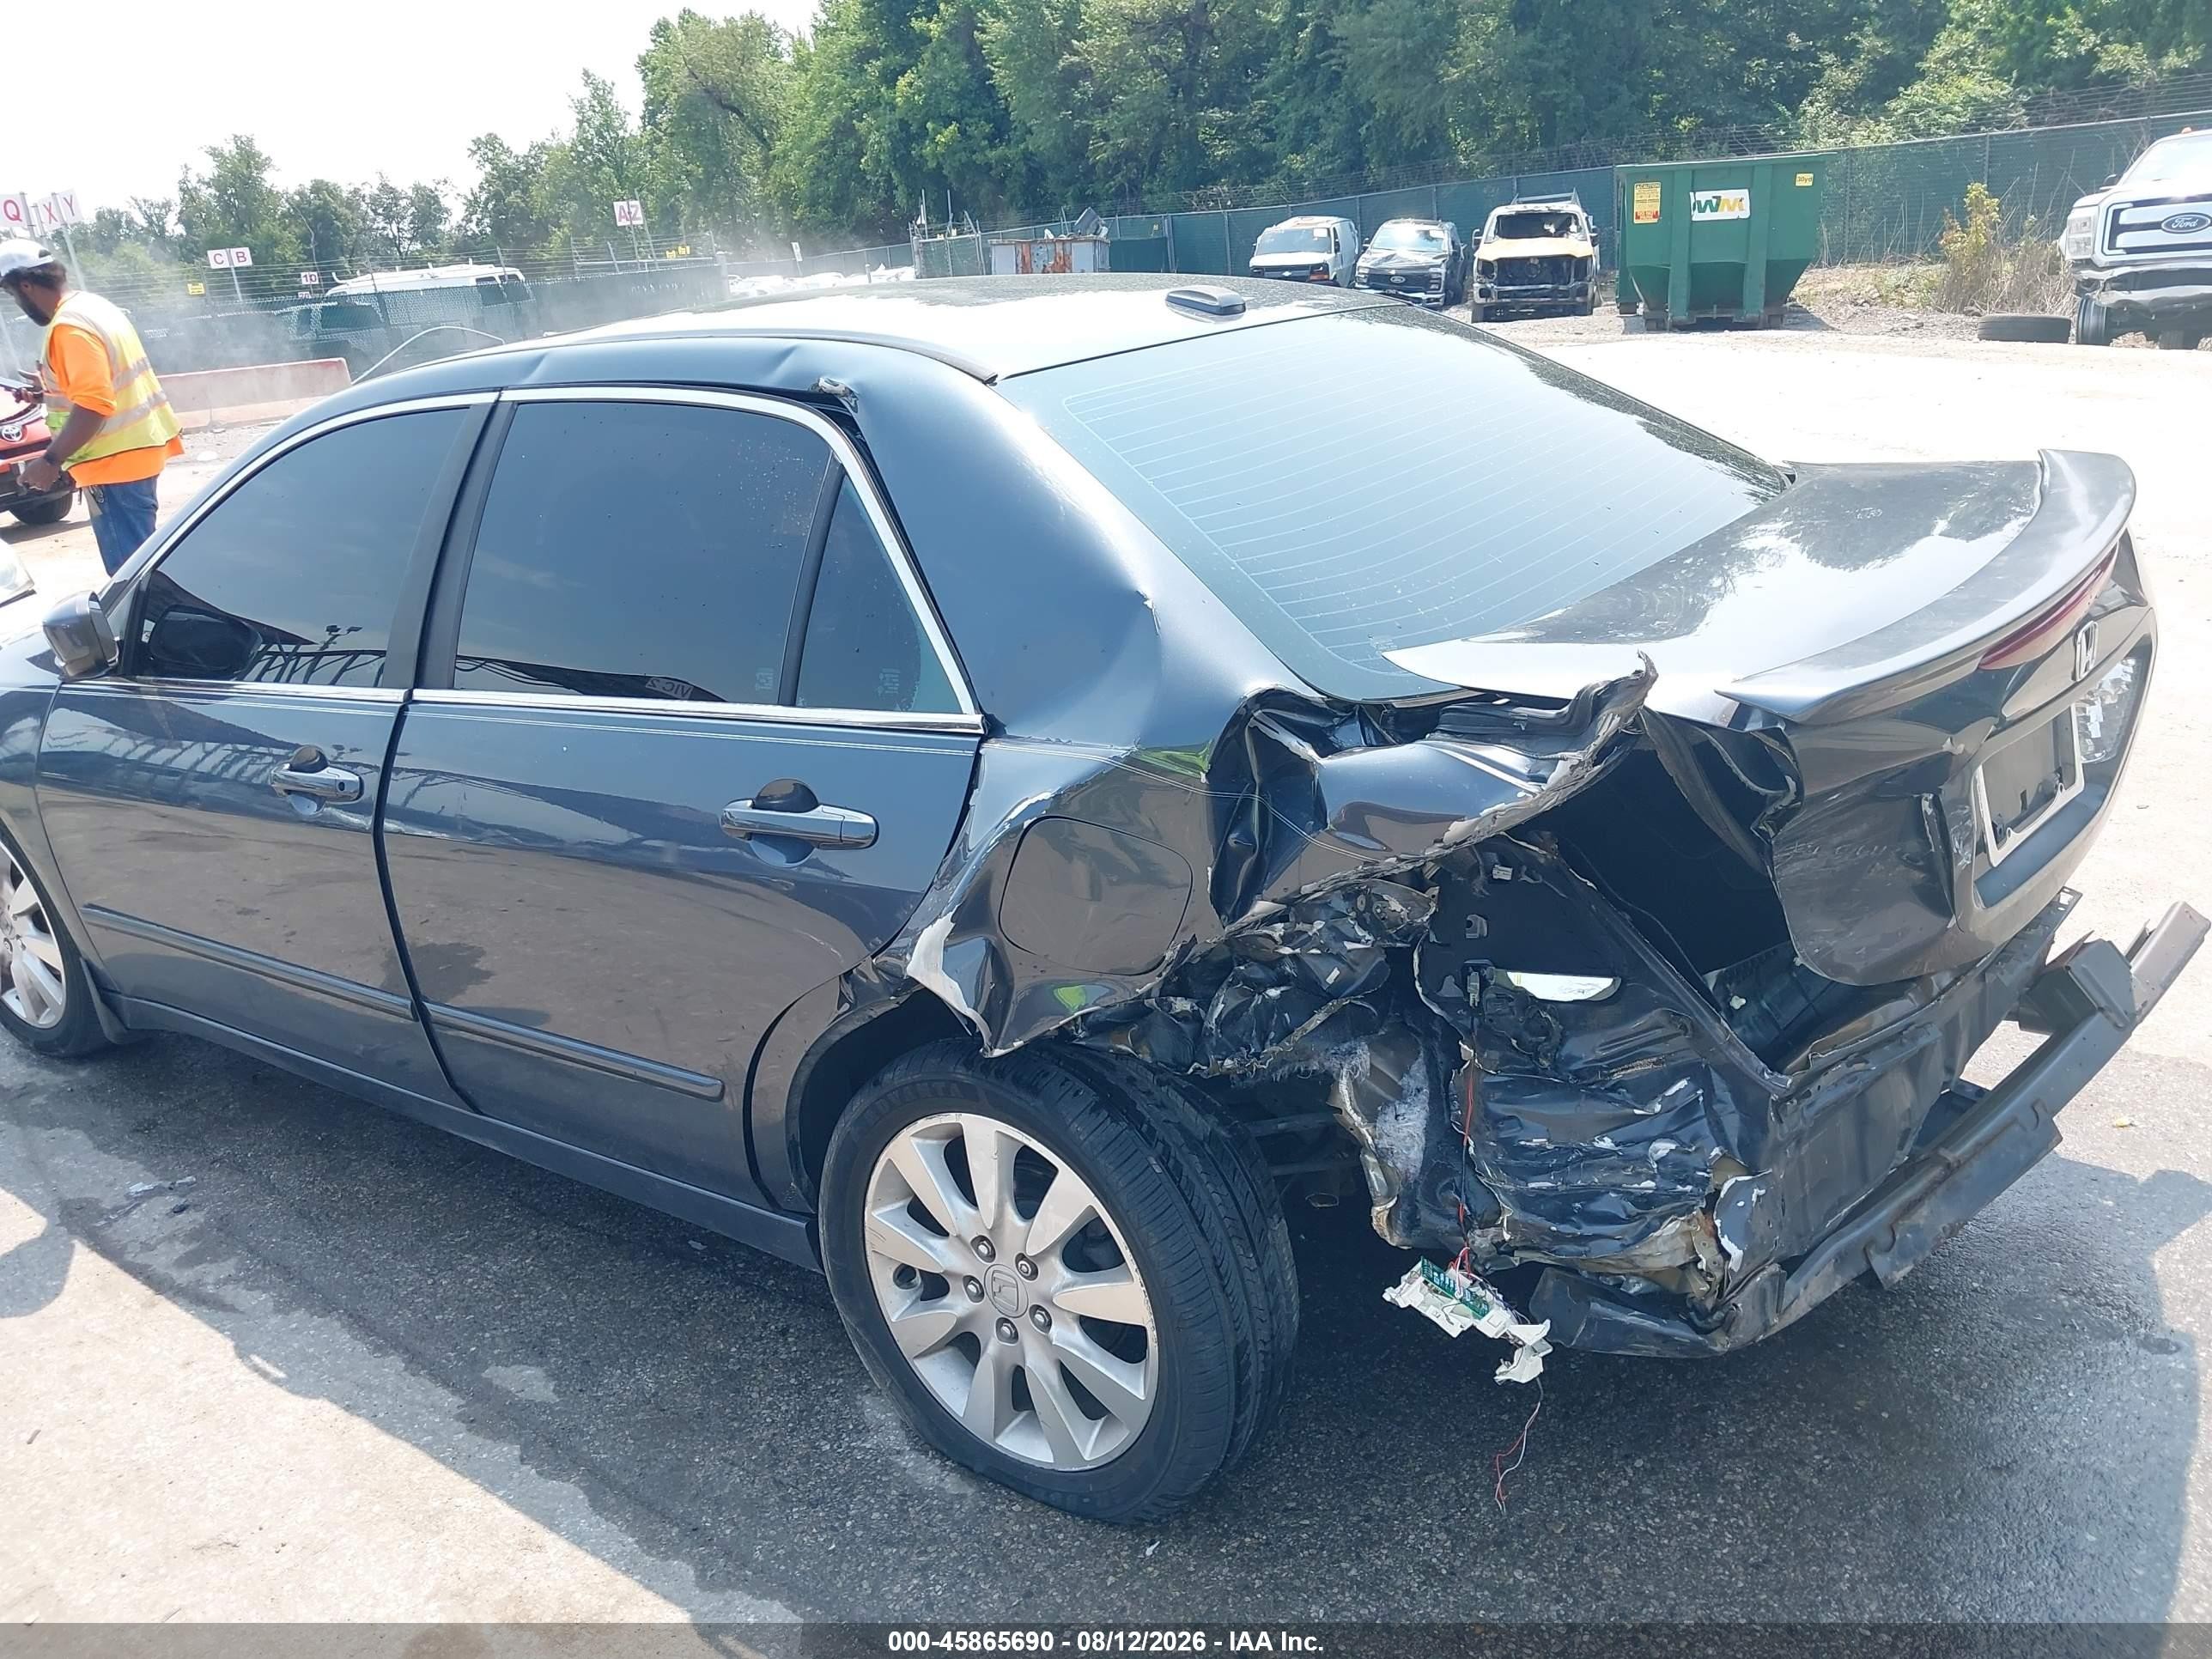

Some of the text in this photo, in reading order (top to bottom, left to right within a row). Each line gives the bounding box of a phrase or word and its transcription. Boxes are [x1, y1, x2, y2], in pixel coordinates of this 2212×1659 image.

[3, 199, 22, 222] Q
[43, 202, 58, 224] X
[64, 195, 76, 216] Y
[2171, 216, 2198, 229] Ford
[213, 253, 224, 265] C
[235, 252, 247, 263] B
[302, 274, 317, 283] 10
[863, 1081, 964, 1127] ADVANTA
